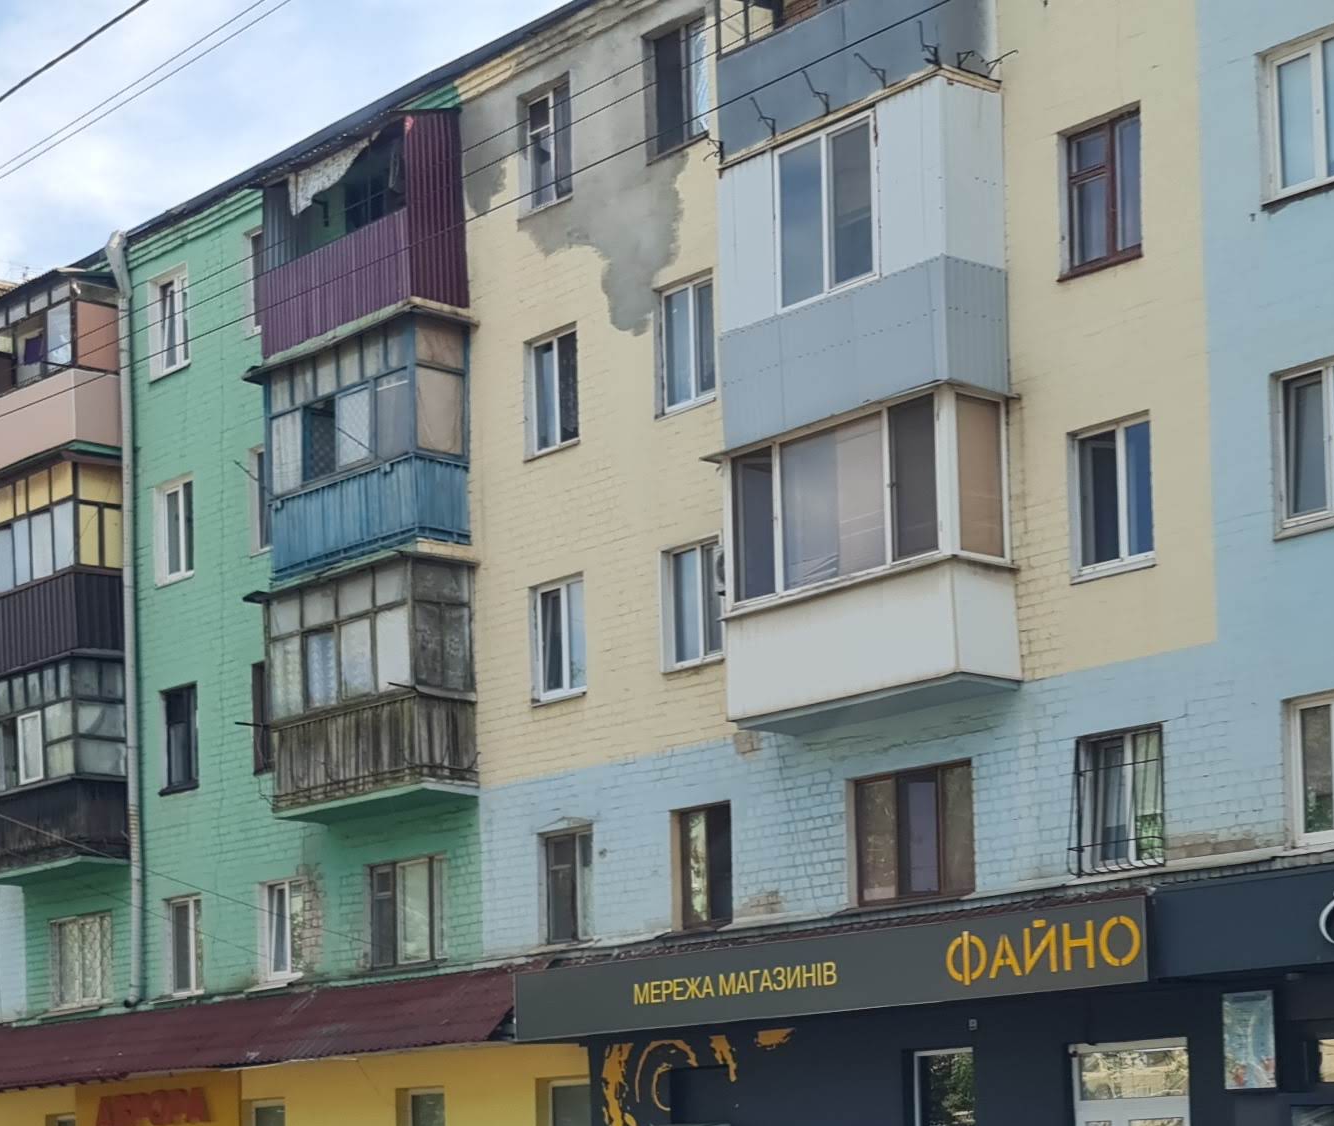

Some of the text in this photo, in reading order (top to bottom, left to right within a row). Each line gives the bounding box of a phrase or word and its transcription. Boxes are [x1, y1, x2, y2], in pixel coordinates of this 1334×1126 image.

[945, 915, 1141, 986] ФАЙНО
[633, 961, 837, 1005] МЕРЕЖА МАГАЗИНІВ
